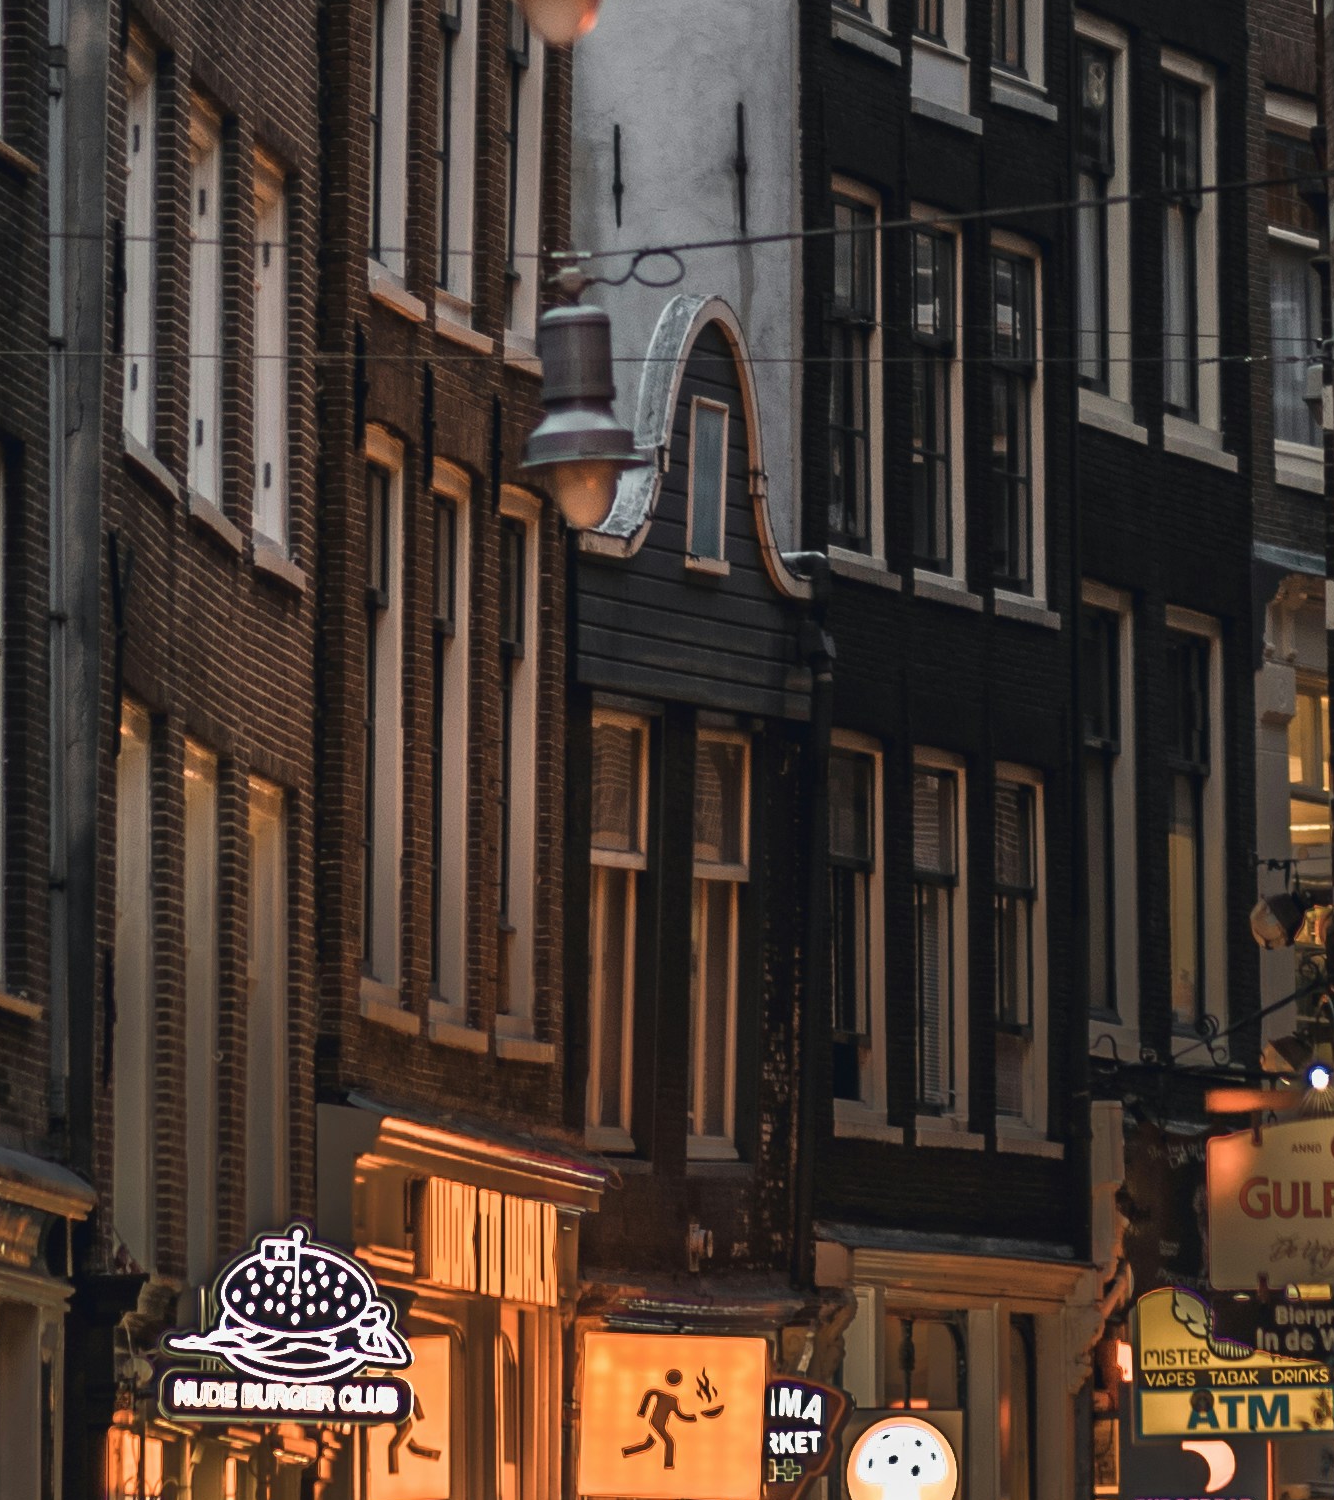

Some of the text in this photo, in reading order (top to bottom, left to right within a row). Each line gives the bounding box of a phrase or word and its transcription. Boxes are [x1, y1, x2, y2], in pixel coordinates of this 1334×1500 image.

[430, 1177, 557, 1307] WOK TO WALK
[1256, 1327, 1279, 1350] In
[1285, 1327, 1315, 1350] de
[1143, 1349, 1210, 1367] MISTER
[1145, 1368, 1329, 1387] VAPES TABAK DRINKS
[173, 1379, 398, 1414] NUDE BURGER CLUB
[1187, 1391, 1290, 1430] ATM
[769, 1431, 822, 1454] RKET
